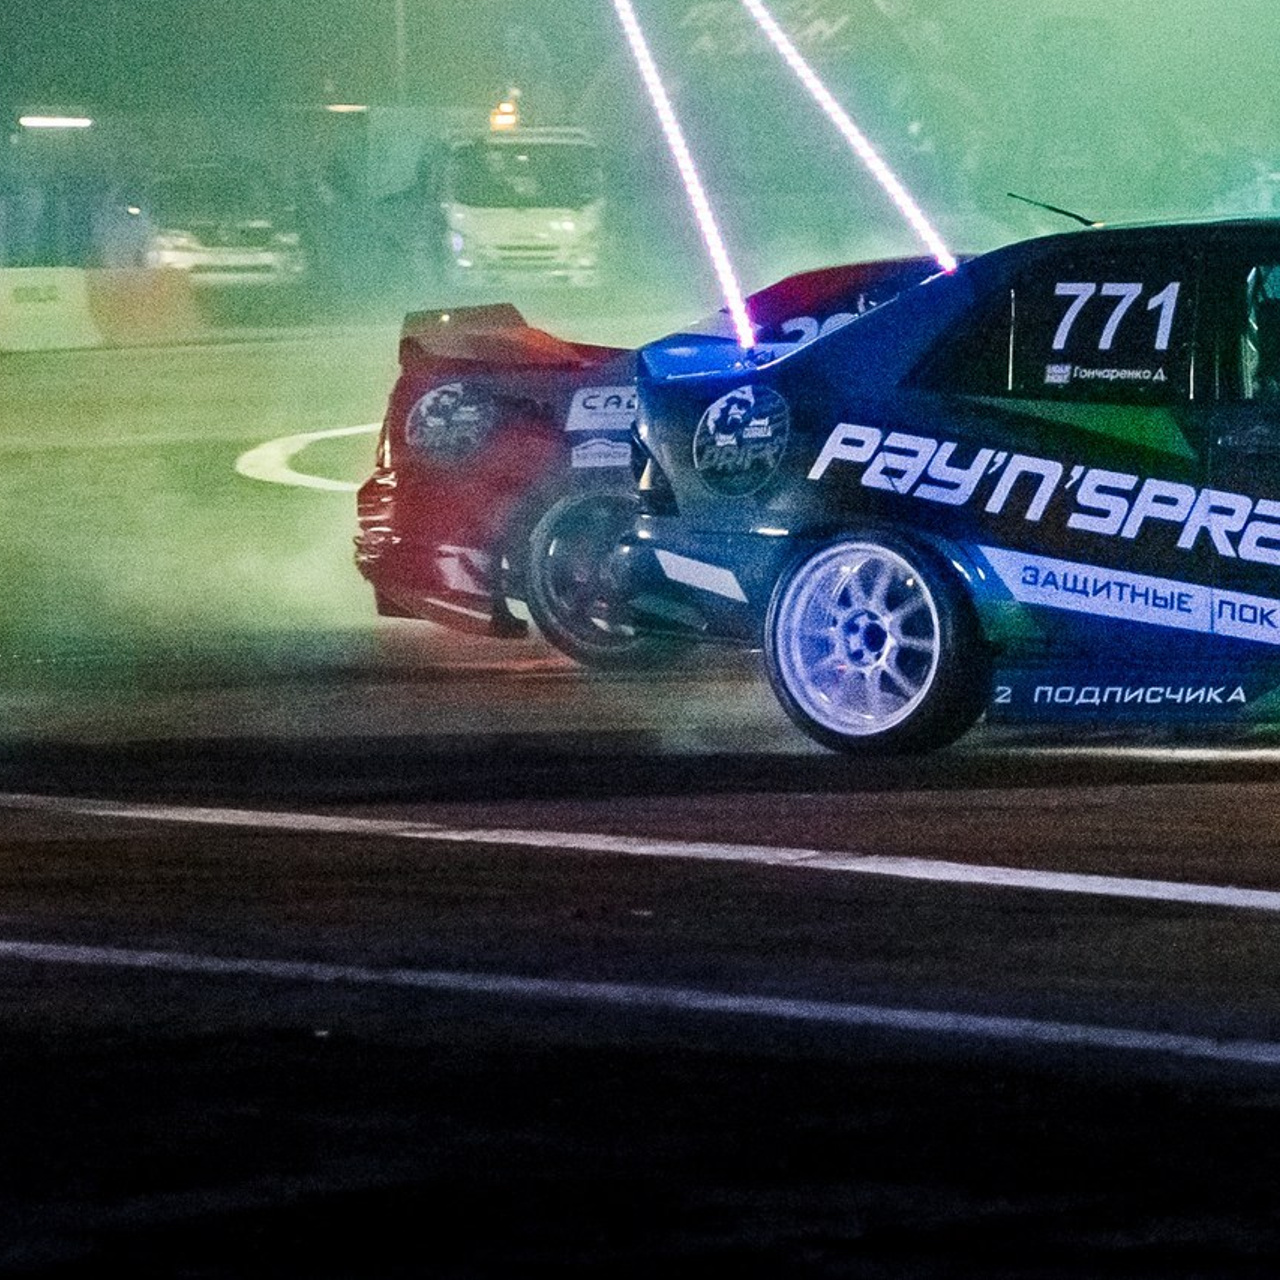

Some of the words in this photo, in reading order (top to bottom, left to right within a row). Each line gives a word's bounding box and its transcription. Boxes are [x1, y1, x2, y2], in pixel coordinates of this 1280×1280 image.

[1052, 281, 1180, 350] 771
[1073, 366, 1151, 382] Гончаренко
[1021, 565, 1194, 614] ЗАЩИТНЫЕ
[994, 686, 1012, 704] 2
[1033, 686, 1247, 706] ПОДПИСЧИКА
